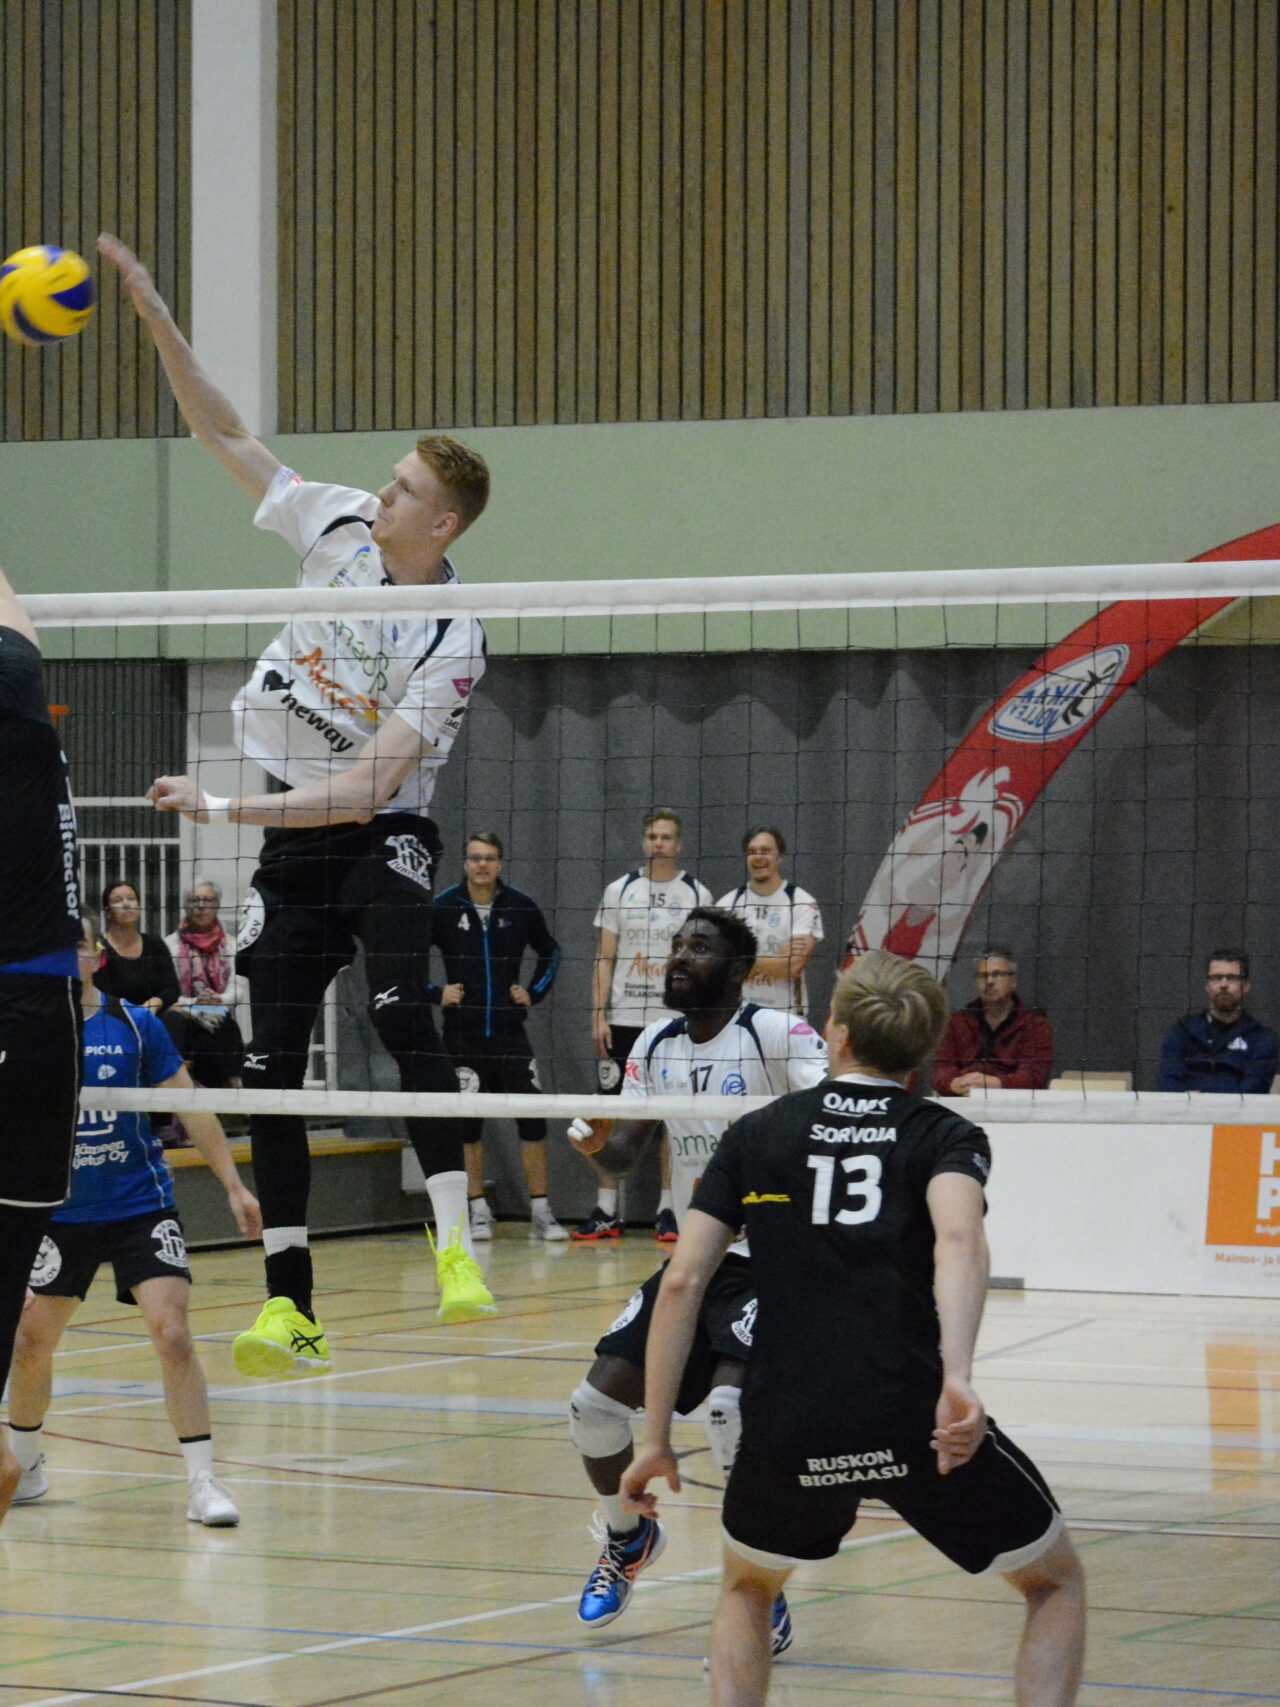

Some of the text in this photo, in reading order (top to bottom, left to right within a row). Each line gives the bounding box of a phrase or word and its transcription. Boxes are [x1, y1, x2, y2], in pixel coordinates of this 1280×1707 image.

[650, 892, 667, 908] 15
[688, 1063, 714, 1095] 17
[808, 1123, 898, 1144] SORVOJA
[108, 1148, 130, 1164] Oy
[806, 1154, 883, 1226] 13
[806, 1448, 895, 1473] RUSKON
[798, 1463, 909, 1488] BIOKAASU
